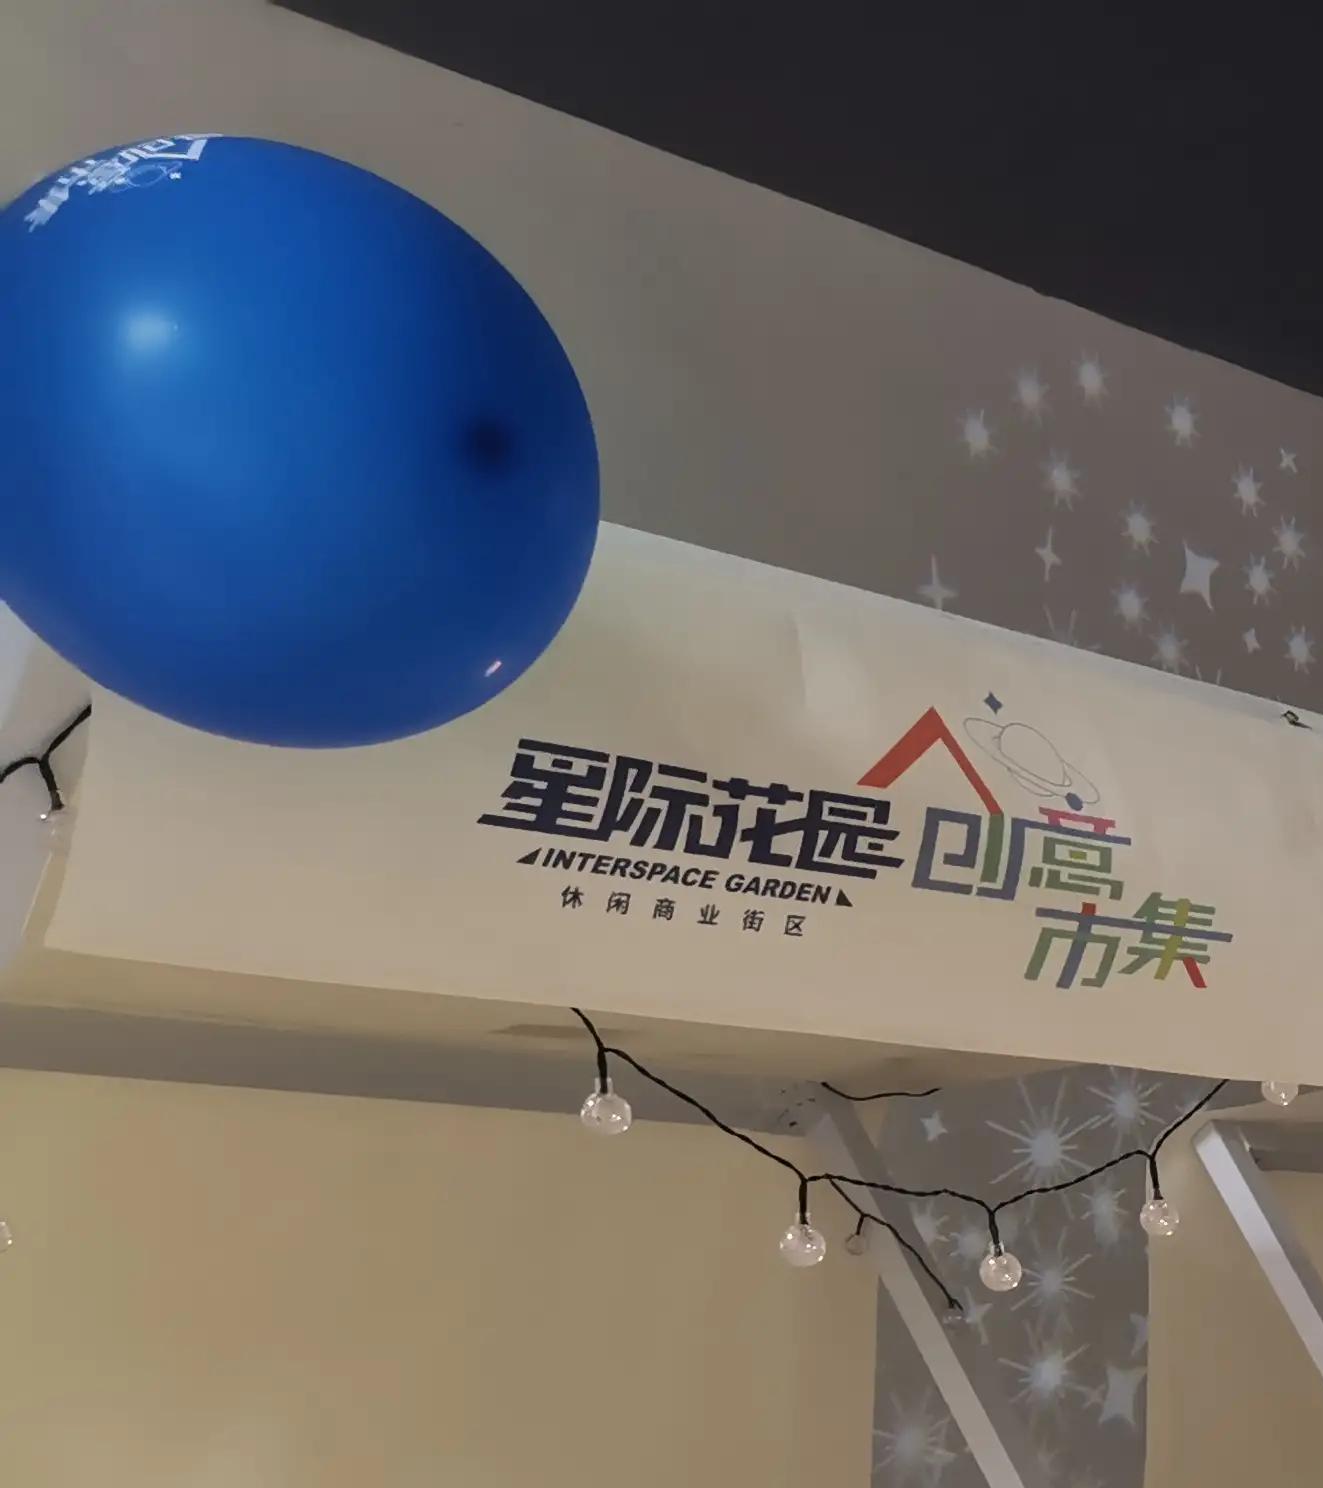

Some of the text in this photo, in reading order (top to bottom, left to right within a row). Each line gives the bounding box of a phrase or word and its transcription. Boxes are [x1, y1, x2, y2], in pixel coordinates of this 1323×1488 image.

[477, 738, 905, 881] 星际花园
[539, 847, 832, 906] INTERSPACE GARDEN
[561, 884, 808, 937] 休闲商业街区
[1024, 892, 1234, 990] 市集
